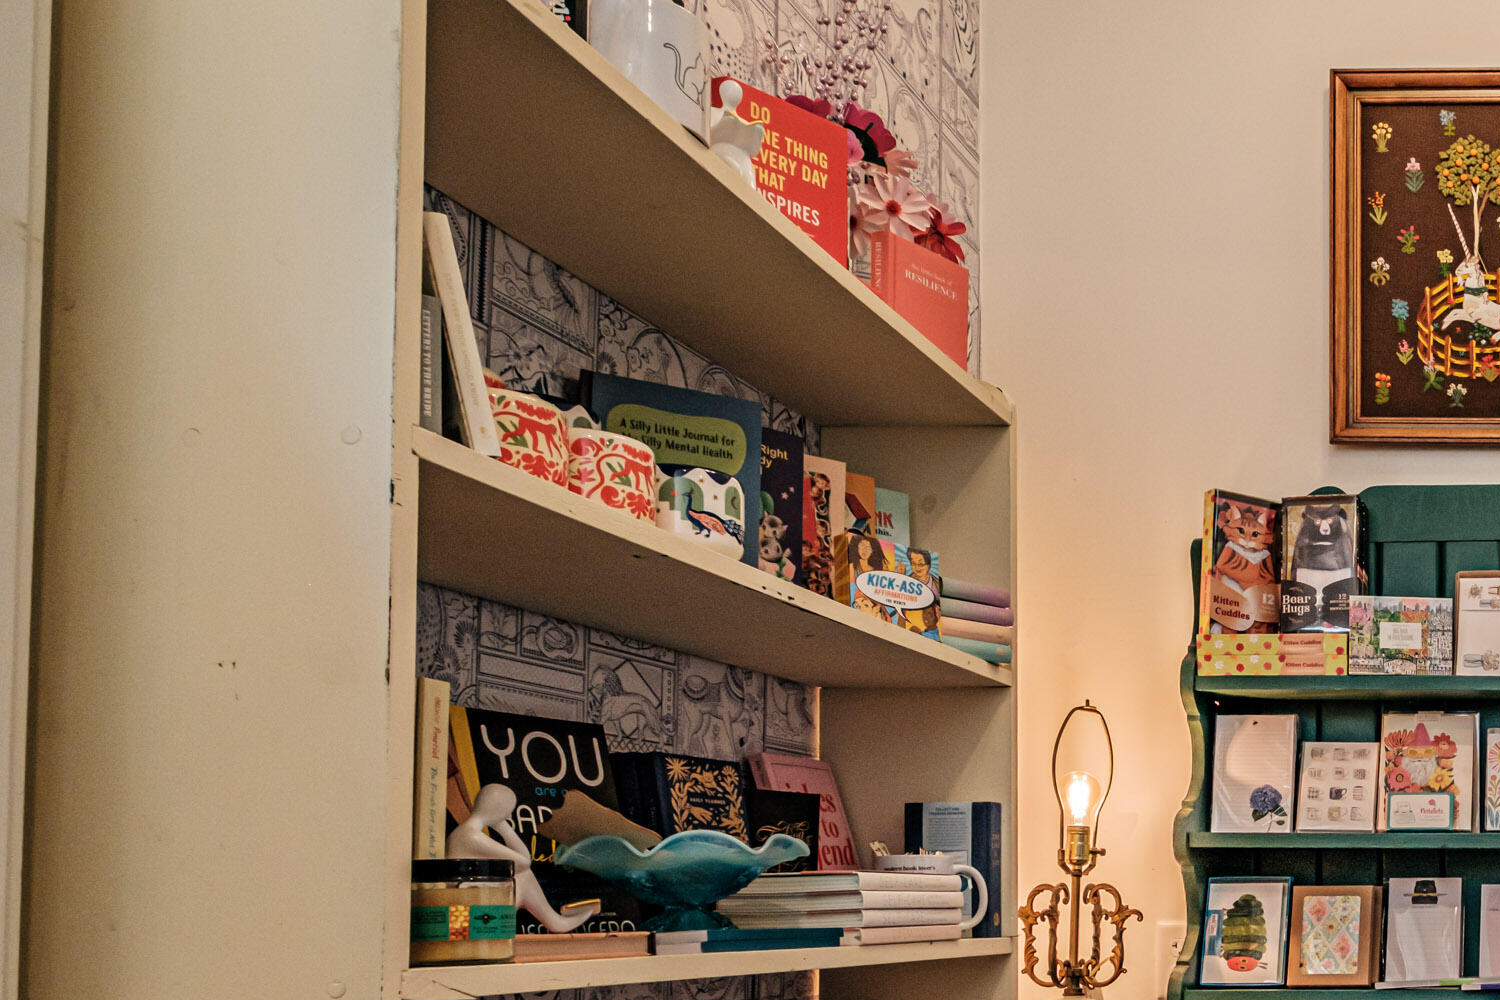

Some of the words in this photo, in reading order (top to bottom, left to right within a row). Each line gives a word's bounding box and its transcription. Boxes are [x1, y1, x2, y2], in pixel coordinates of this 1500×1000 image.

[750, 101, 771, 125] DO
[762, 129, 780, 151] NE
[785, 136, 829, 170] THING
[752, 148, 796, 177] VERY
[802, 166, 828, 190] DAY
[753, 166, 785, 192] THAT
[754, 188, 820, 227] NSPIRES
[905, 269, 958, 301] RESILIENCE
[630, 419, 650, 432] Silly
[654, 423, 680, 437] Little
[683, 428, 718, 444] Journal
[721, 435, 735, 447] for
[641, 436, 662, 450] Silly
[665, 438, 700, 455] Mental
[702, 445, 733, 460] Health
[867, 573, 923, 596] KICK-ASS
[1213, 595, 1240, 607] Kitten
[1282, 594, 1311, 605] Bear
[1282, 605, 1311, 616] Hugs
[1215, 607, 1251, 621] Cuddles
[480, 724, 604, 787] YOU
[535, 786, 557, 797] are
